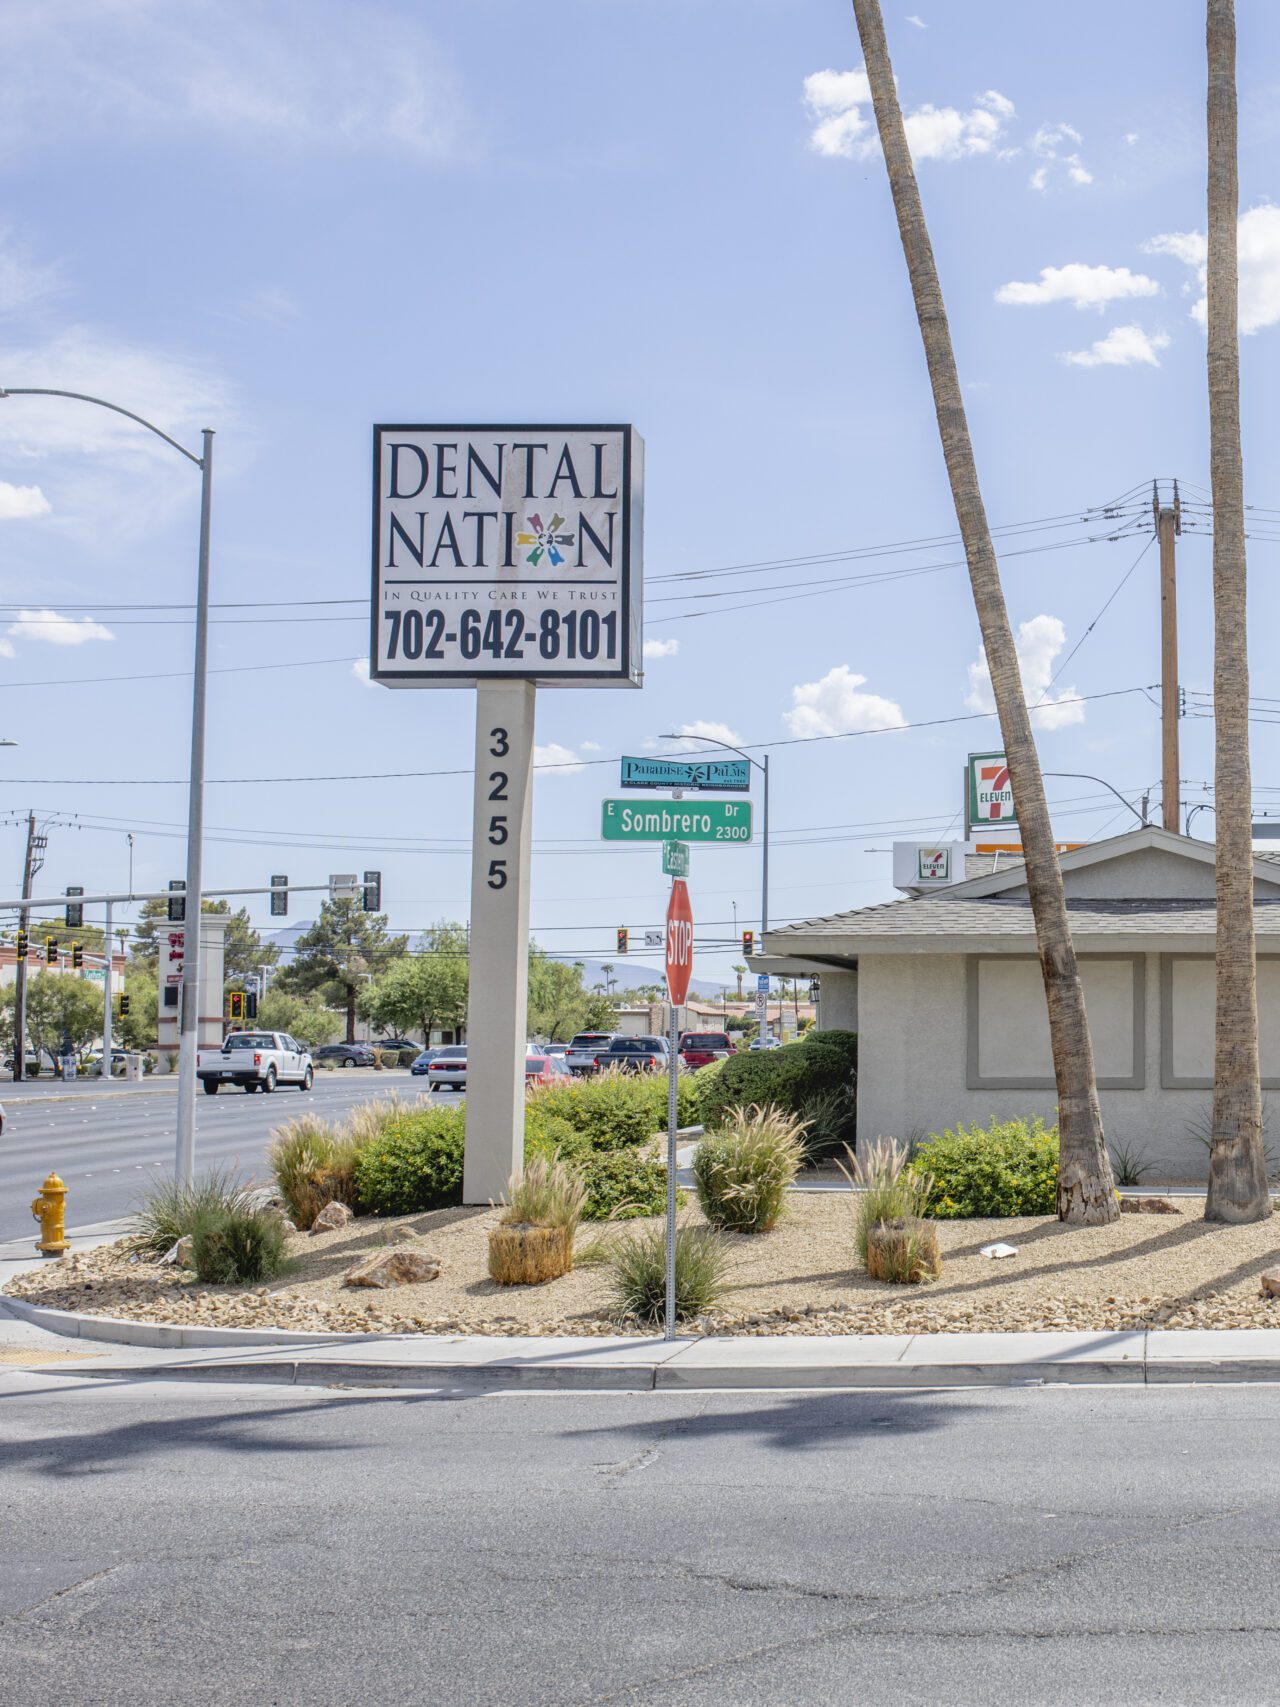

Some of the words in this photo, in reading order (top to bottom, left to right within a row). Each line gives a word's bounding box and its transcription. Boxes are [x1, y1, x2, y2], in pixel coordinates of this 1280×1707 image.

[386, 442, 618, 500] DENTAL
[385, 511, 618, 568] NATIN
[410, 591, 479, 602] QUALITY
[488, 591, 528, 601] CARE
[537, 591, 558, 600] WE
[568, 591, 618, 600] TRUST
[384, 608, 617, 660] 702-642-8101
[607, 803, 615, 815] E
[621, 808, 711, 833] Sombrero
[725, 804, 739, 816] Dr
[716, 826, 748, 839] 2300
[668, 919, 692, 966] STOP
